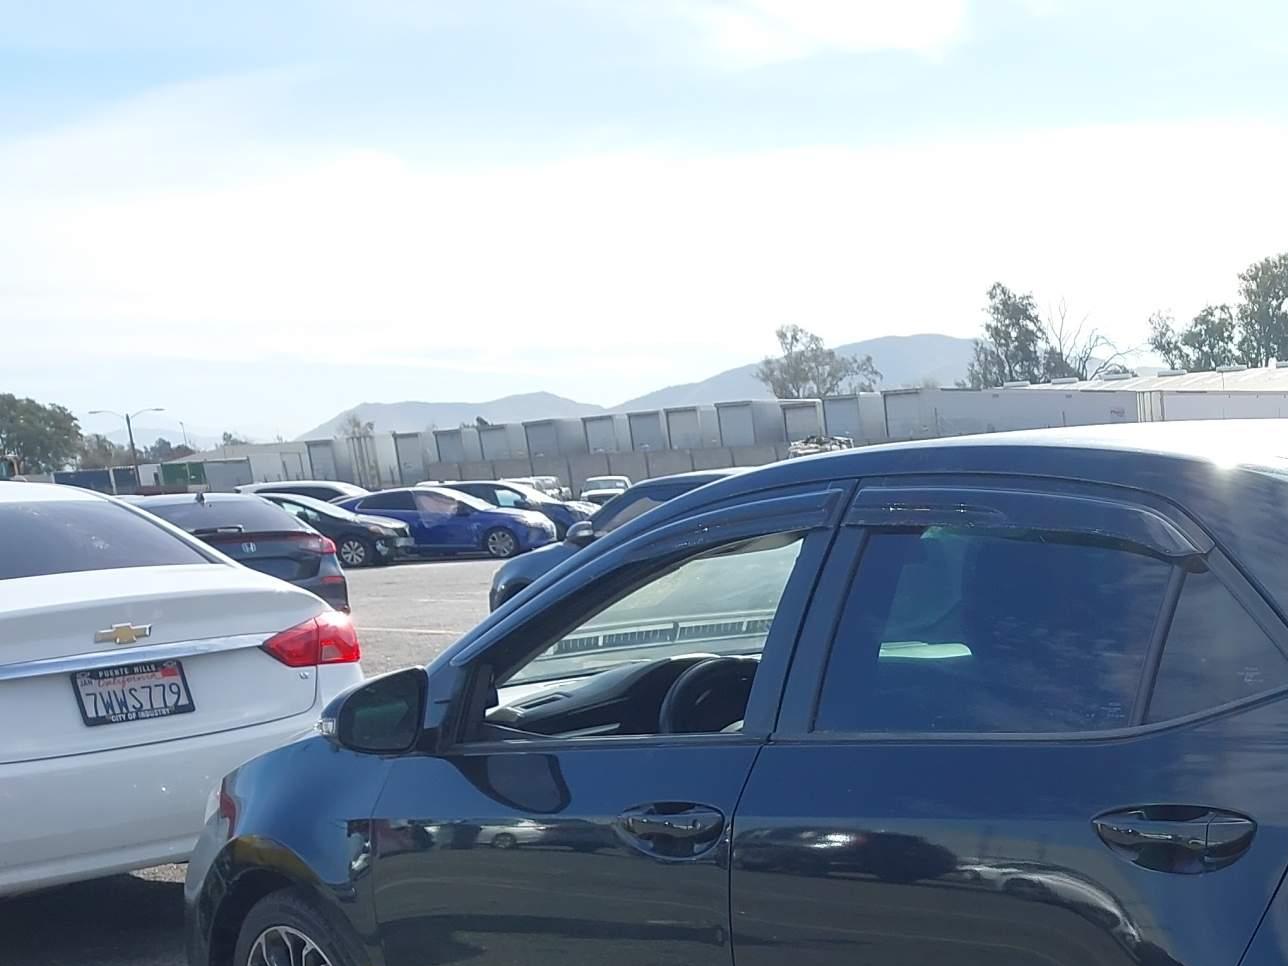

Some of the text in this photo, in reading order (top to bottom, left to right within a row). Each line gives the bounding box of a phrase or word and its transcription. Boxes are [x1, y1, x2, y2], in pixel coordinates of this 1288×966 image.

[98, 663, 157, 678] PUENTE HILLS
[79, 678, 93, 687] JAN
[85, 682, 181, 718] 7WWS779
[111, 708, 171, 722] CITY OF INDUSTRY
